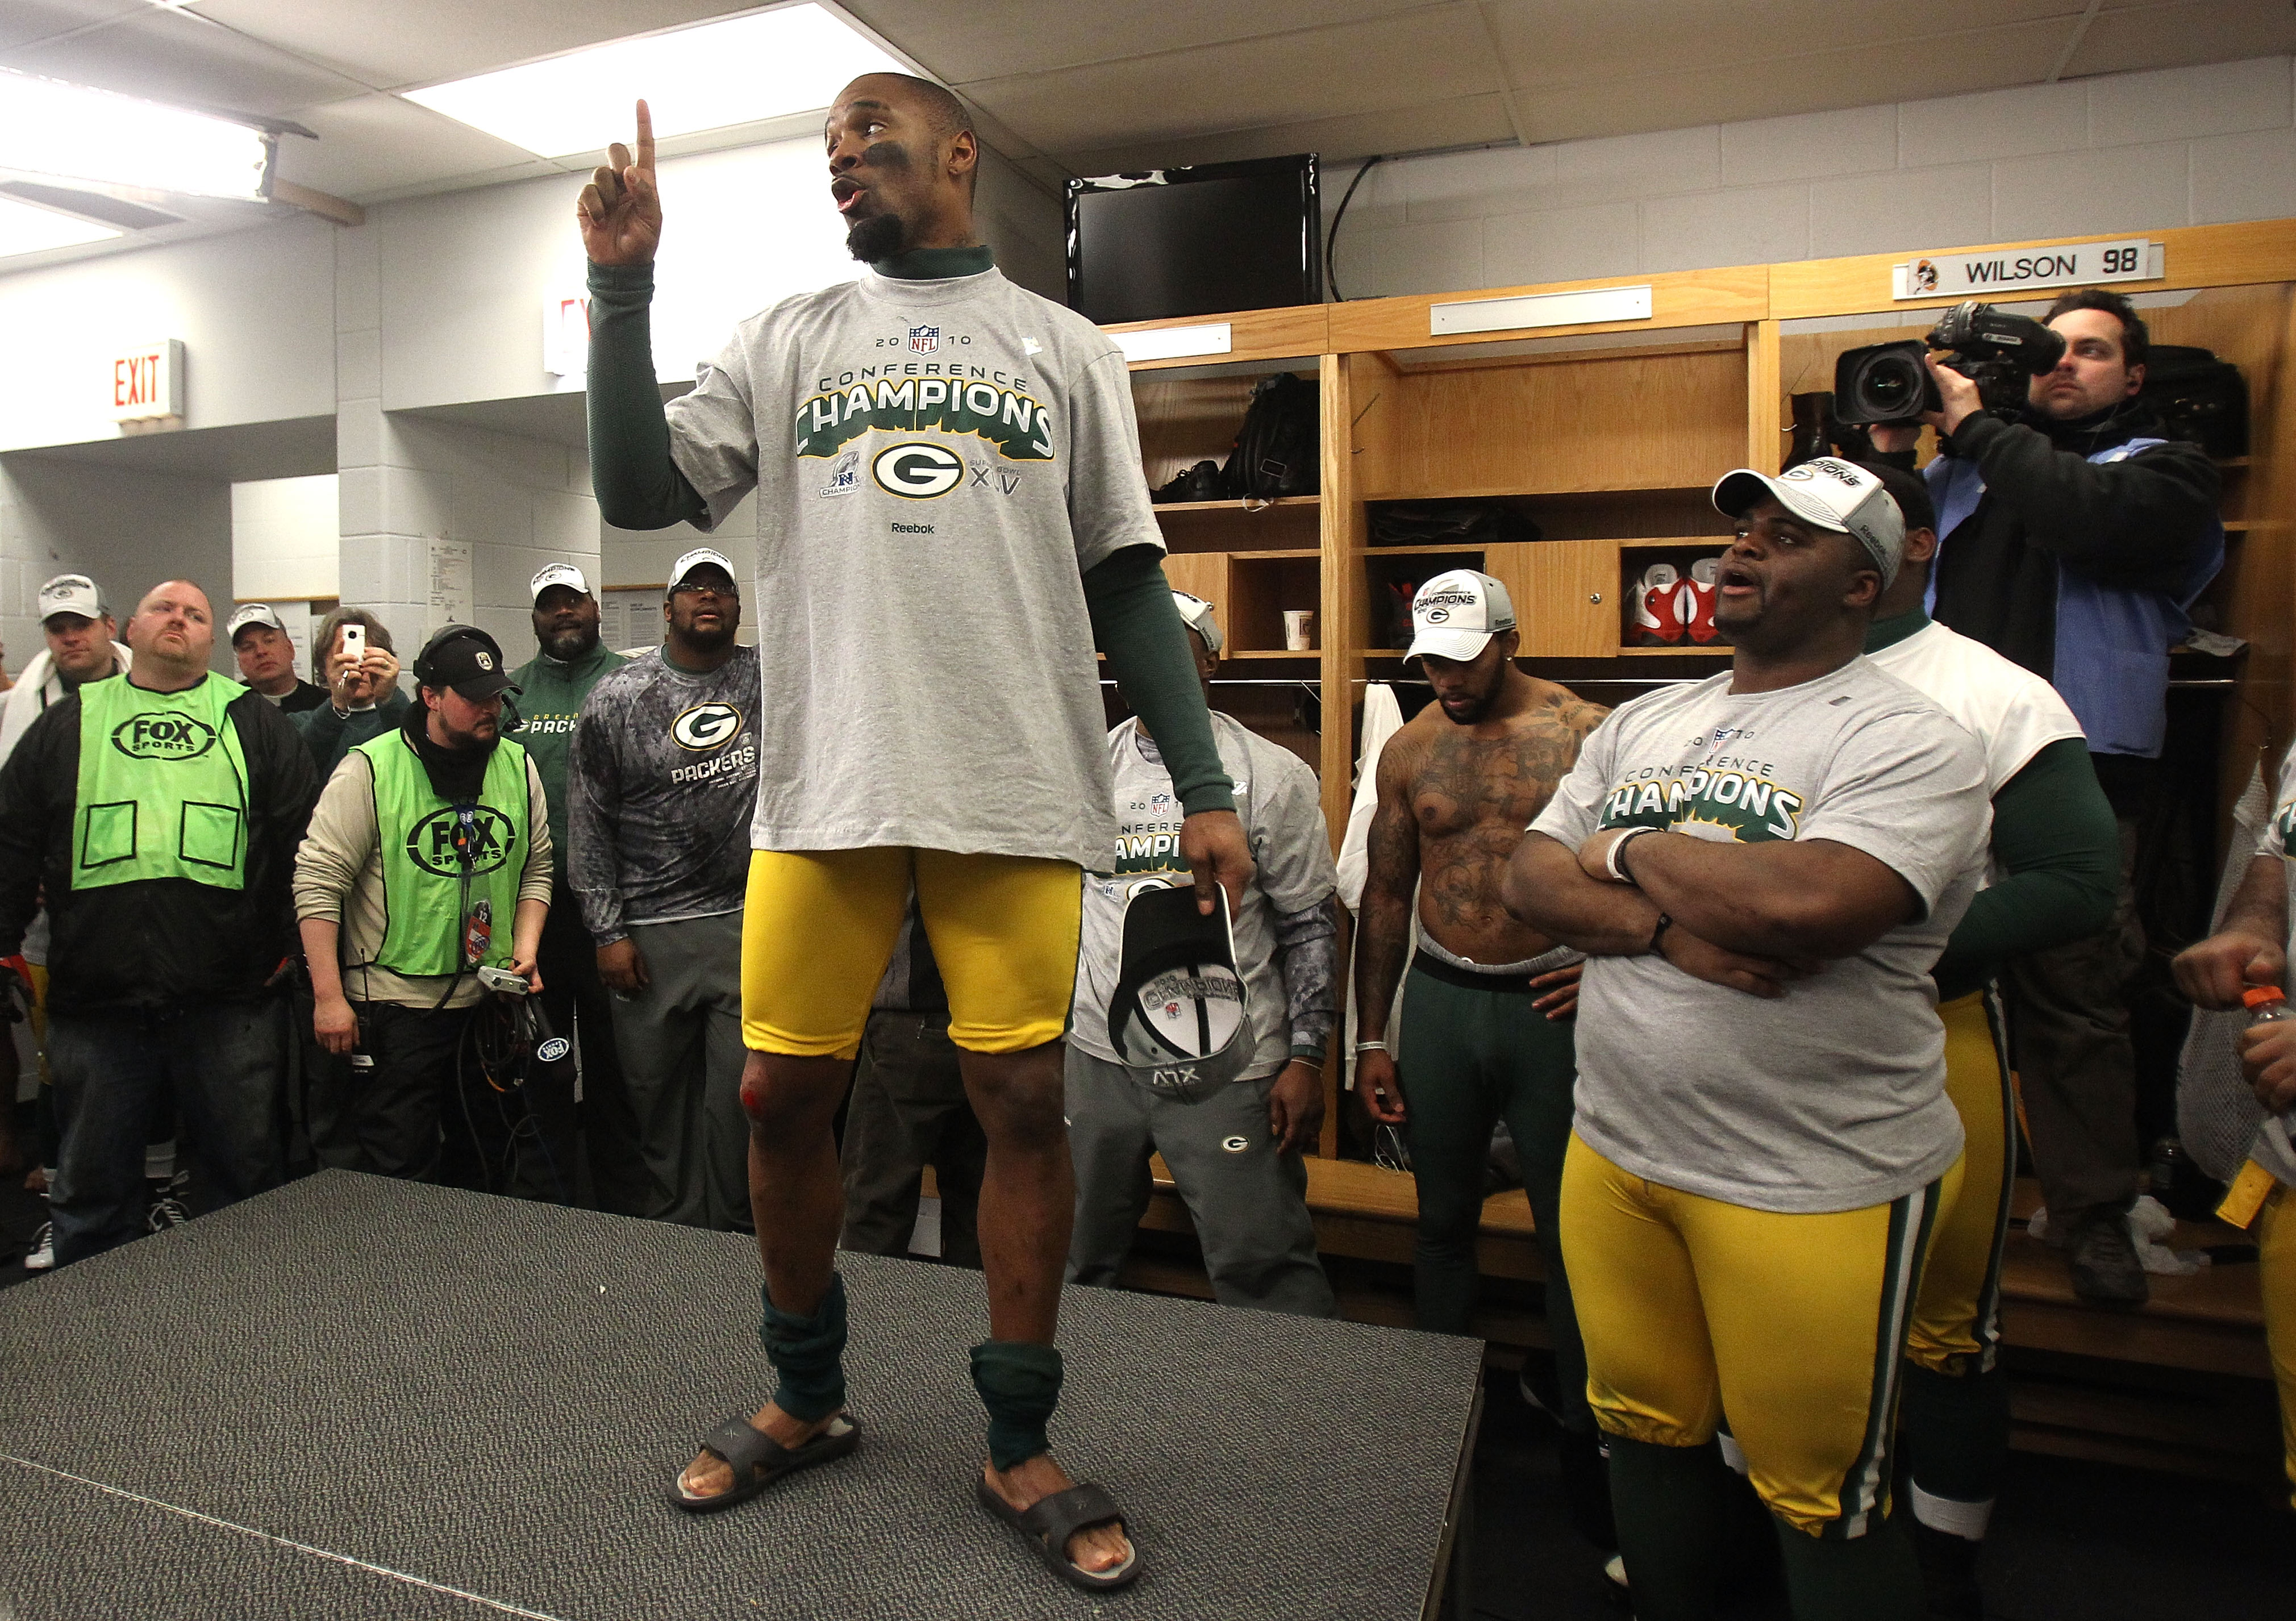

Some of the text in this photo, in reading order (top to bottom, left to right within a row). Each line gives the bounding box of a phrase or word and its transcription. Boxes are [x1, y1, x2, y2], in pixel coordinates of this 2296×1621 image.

[1966, 247, 2138, 283] WILSON 98
[876, 336, 971, 352] 20 NFL 10
[115, 355, 159, 406] EXIT
[819, 363, 1027, 393] CONFERENCE
[796, 378, 1055, 458] CHAMPIONS
[997, 466, 1021, 476] BOWL
[891, 522, 935, 534] Reebok
[1414, 595, 1477, 611] CHAMPIONS
[134, 720, 194, 745] FOX
[132, 741, 194, 752] SPORTS
[671, 745, 755, 784] PACKERS
[1153, 803, 1167, 814] NFL
[431, 816, 501, 855] FOX
[479, 910, 487, 923] 12
[543, 1041, 565, 1059] FOX
